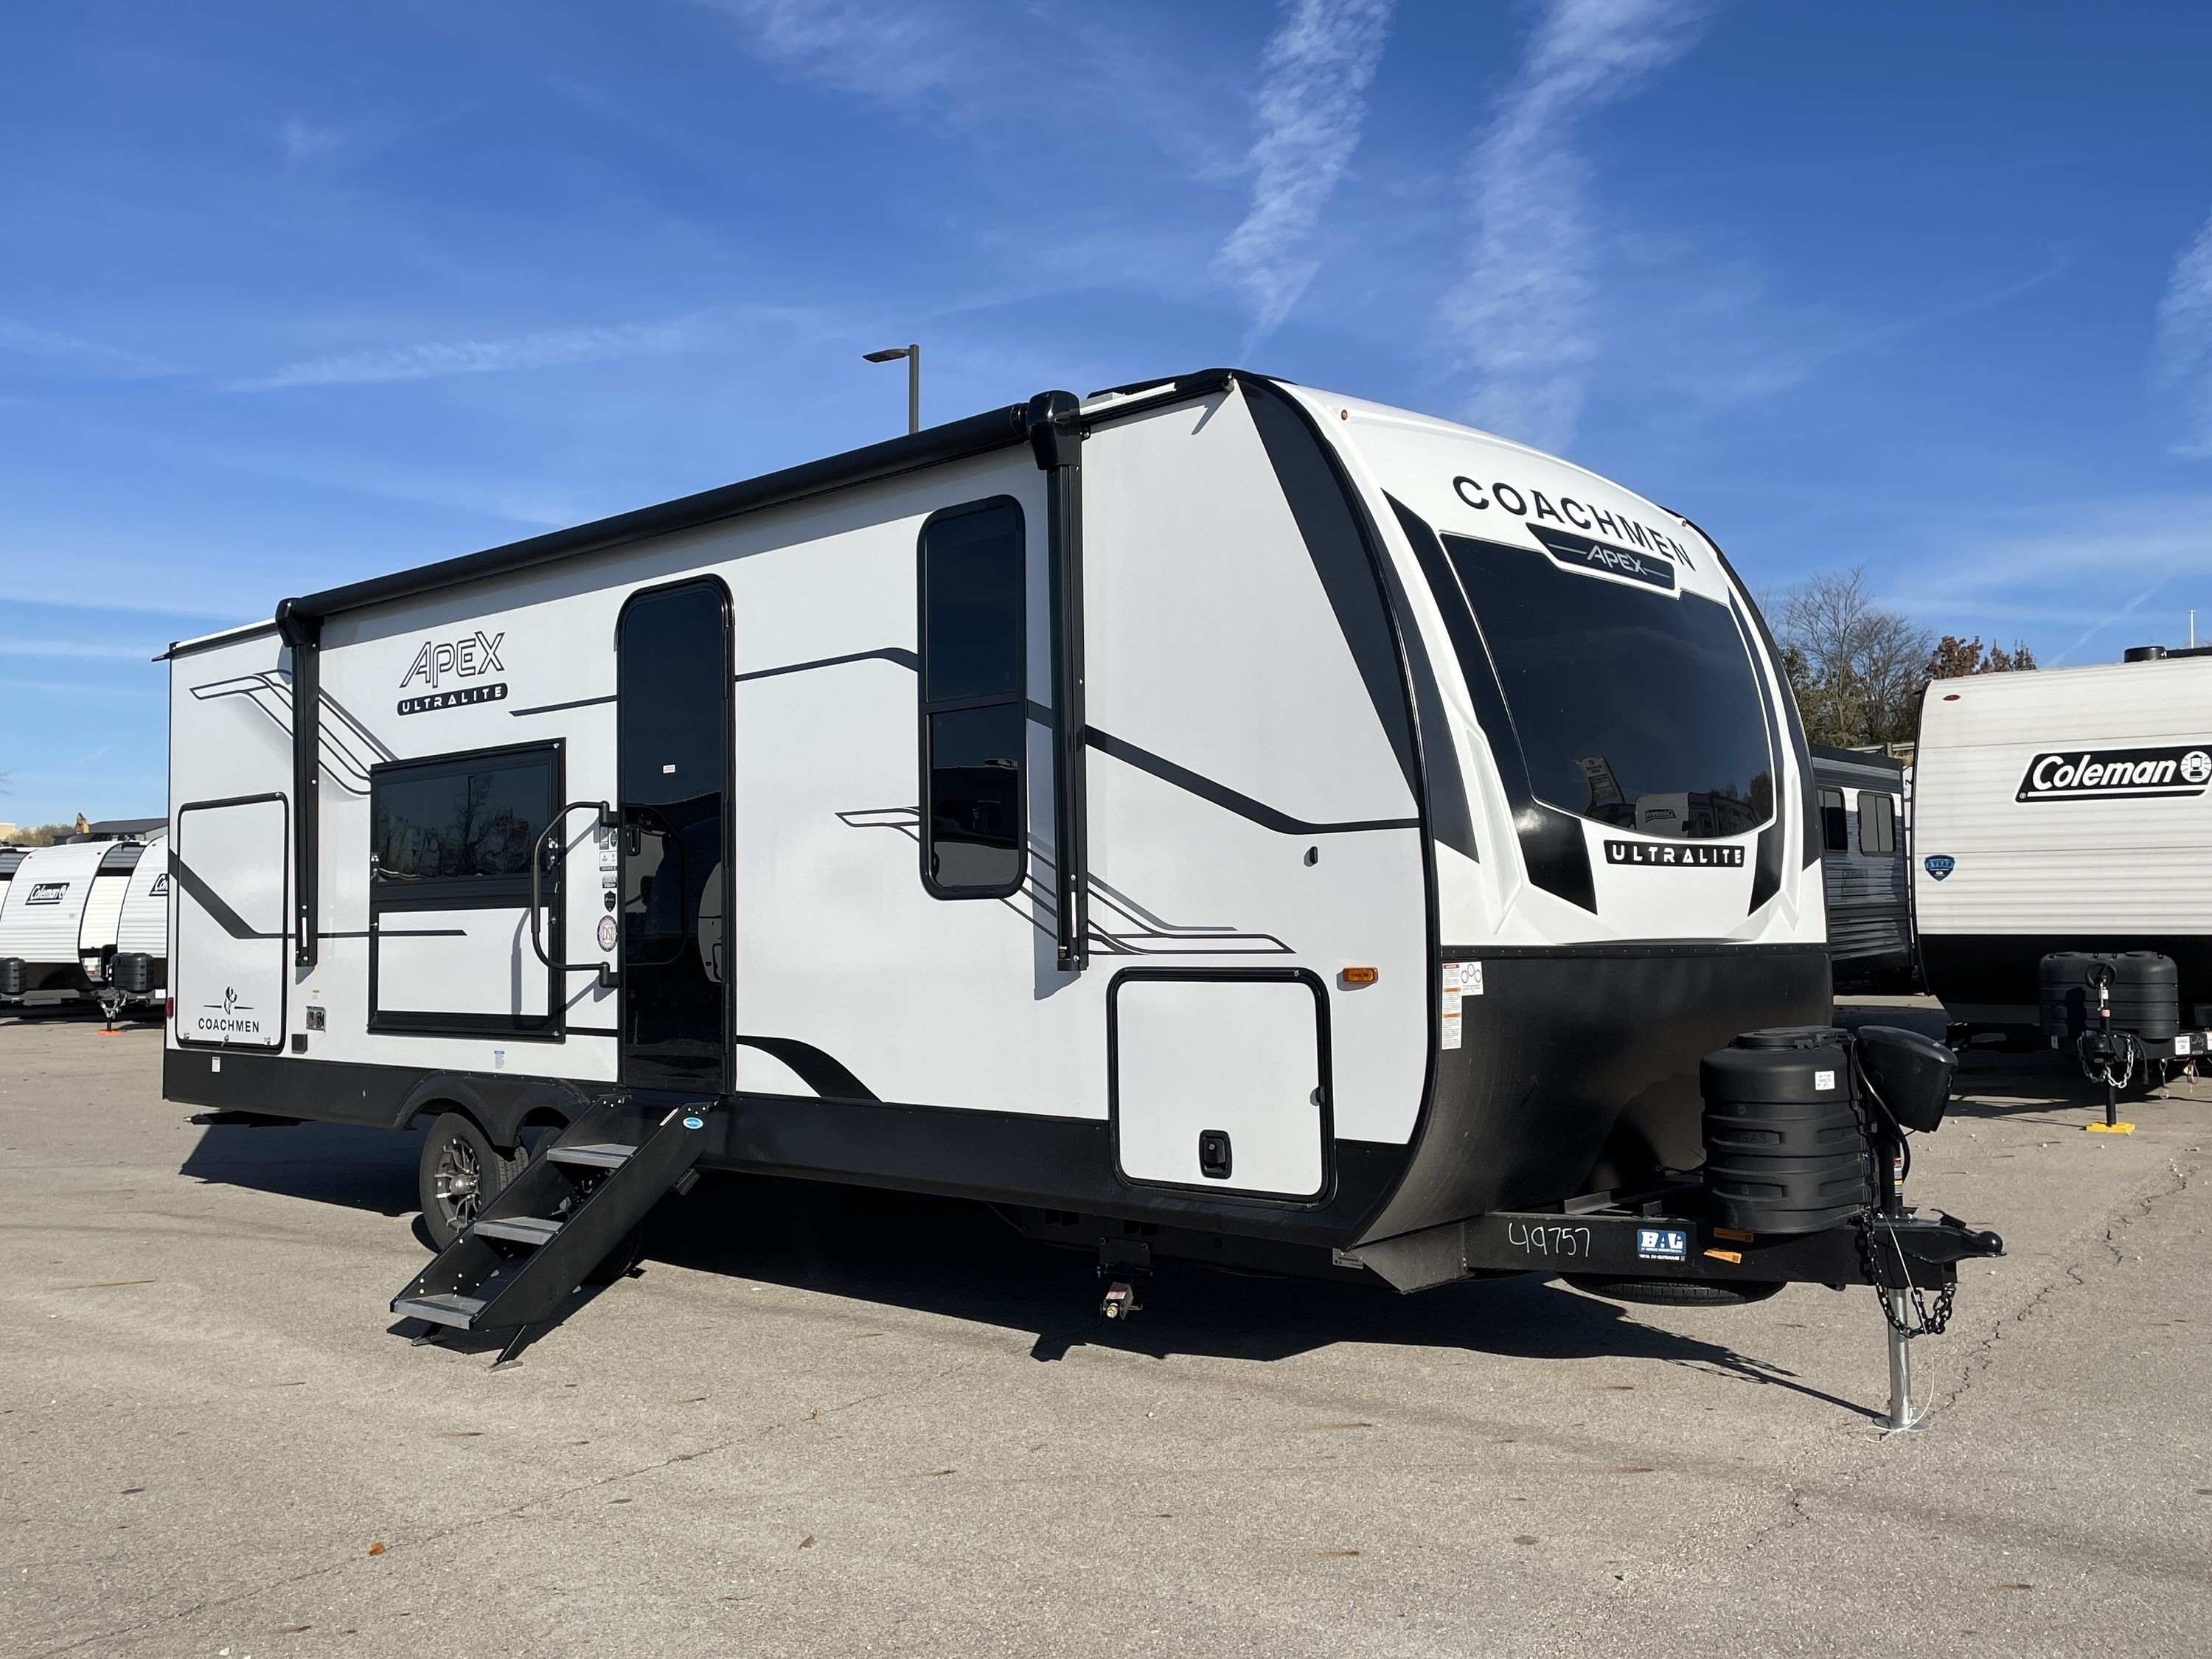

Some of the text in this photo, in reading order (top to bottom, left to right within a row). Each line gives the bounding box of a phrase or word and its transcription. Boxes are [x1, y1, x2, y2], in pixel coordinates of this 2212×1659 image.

[1453, 476, 1696, 571] COACHMEN
[1587, 544, 1647, 576] APEX
[398, 630, 506, 689] APEX
[402, 686, 502, 712] ULTRALITE
[2032, 754, 2177, 790] Coleman
[1613, 844, 1742, 864] ULTRALITE
[198, 1018, 260, 1033] COACHMEN
[1509, 1222, 1590, 1258] 49757
